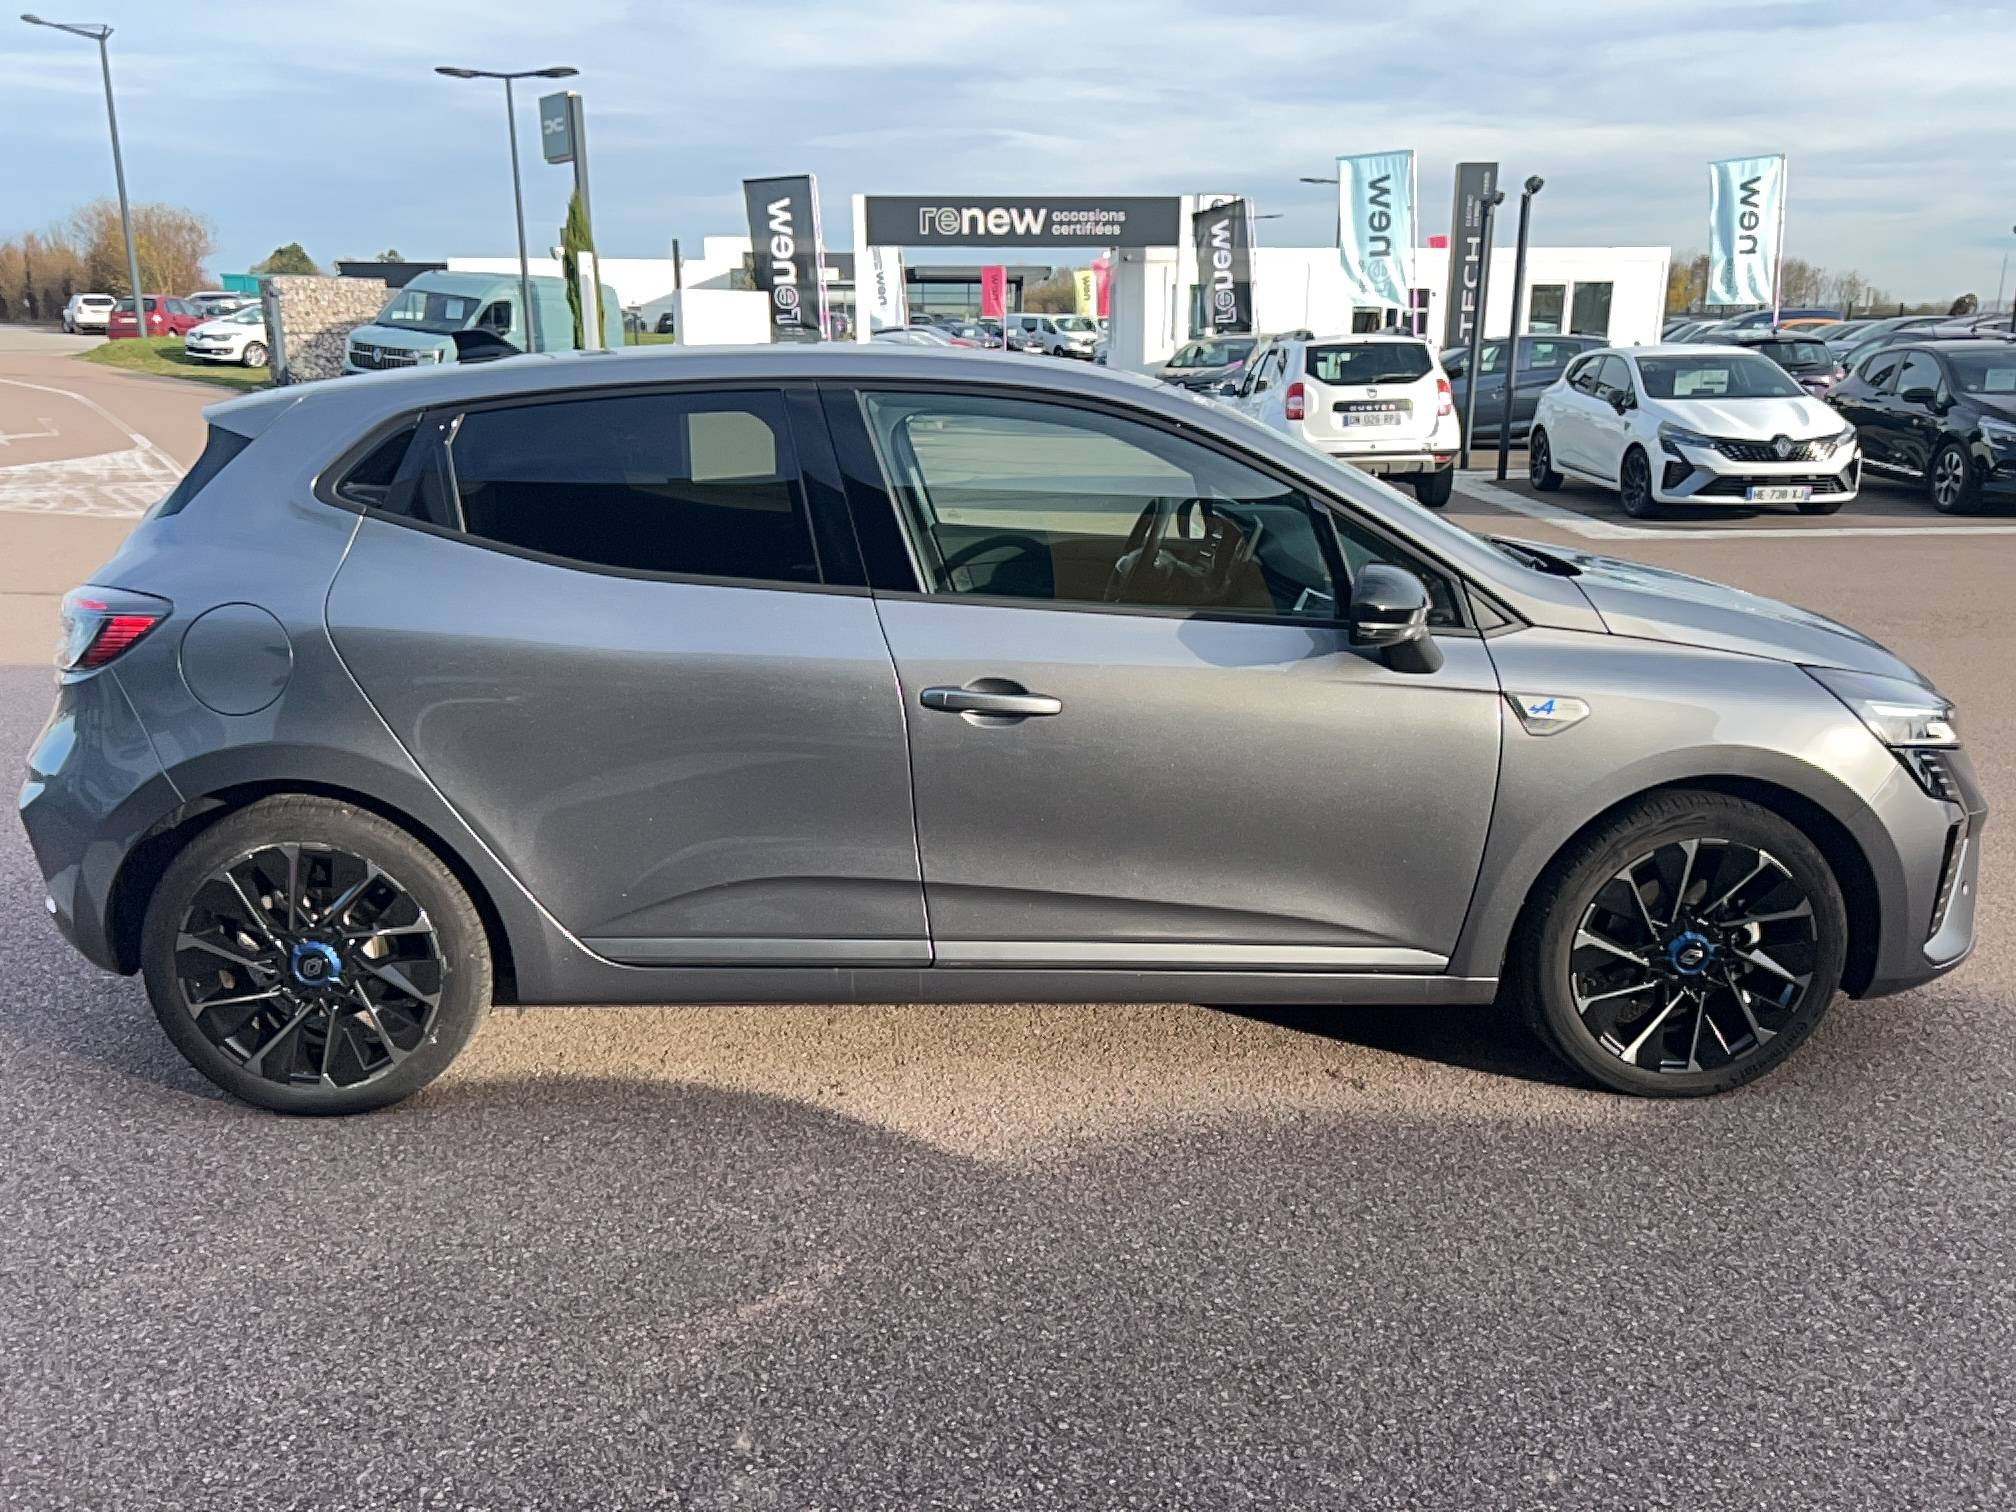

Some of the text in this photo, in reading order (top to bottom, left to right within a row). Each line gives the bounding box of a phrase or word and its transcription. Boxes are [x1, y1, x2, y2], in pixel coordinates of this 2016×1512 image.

[919, 206, 1048, 236] renew
[1052, 208, 1126, 222] occasions
[1051, 221, 1122, 236] certifiées
